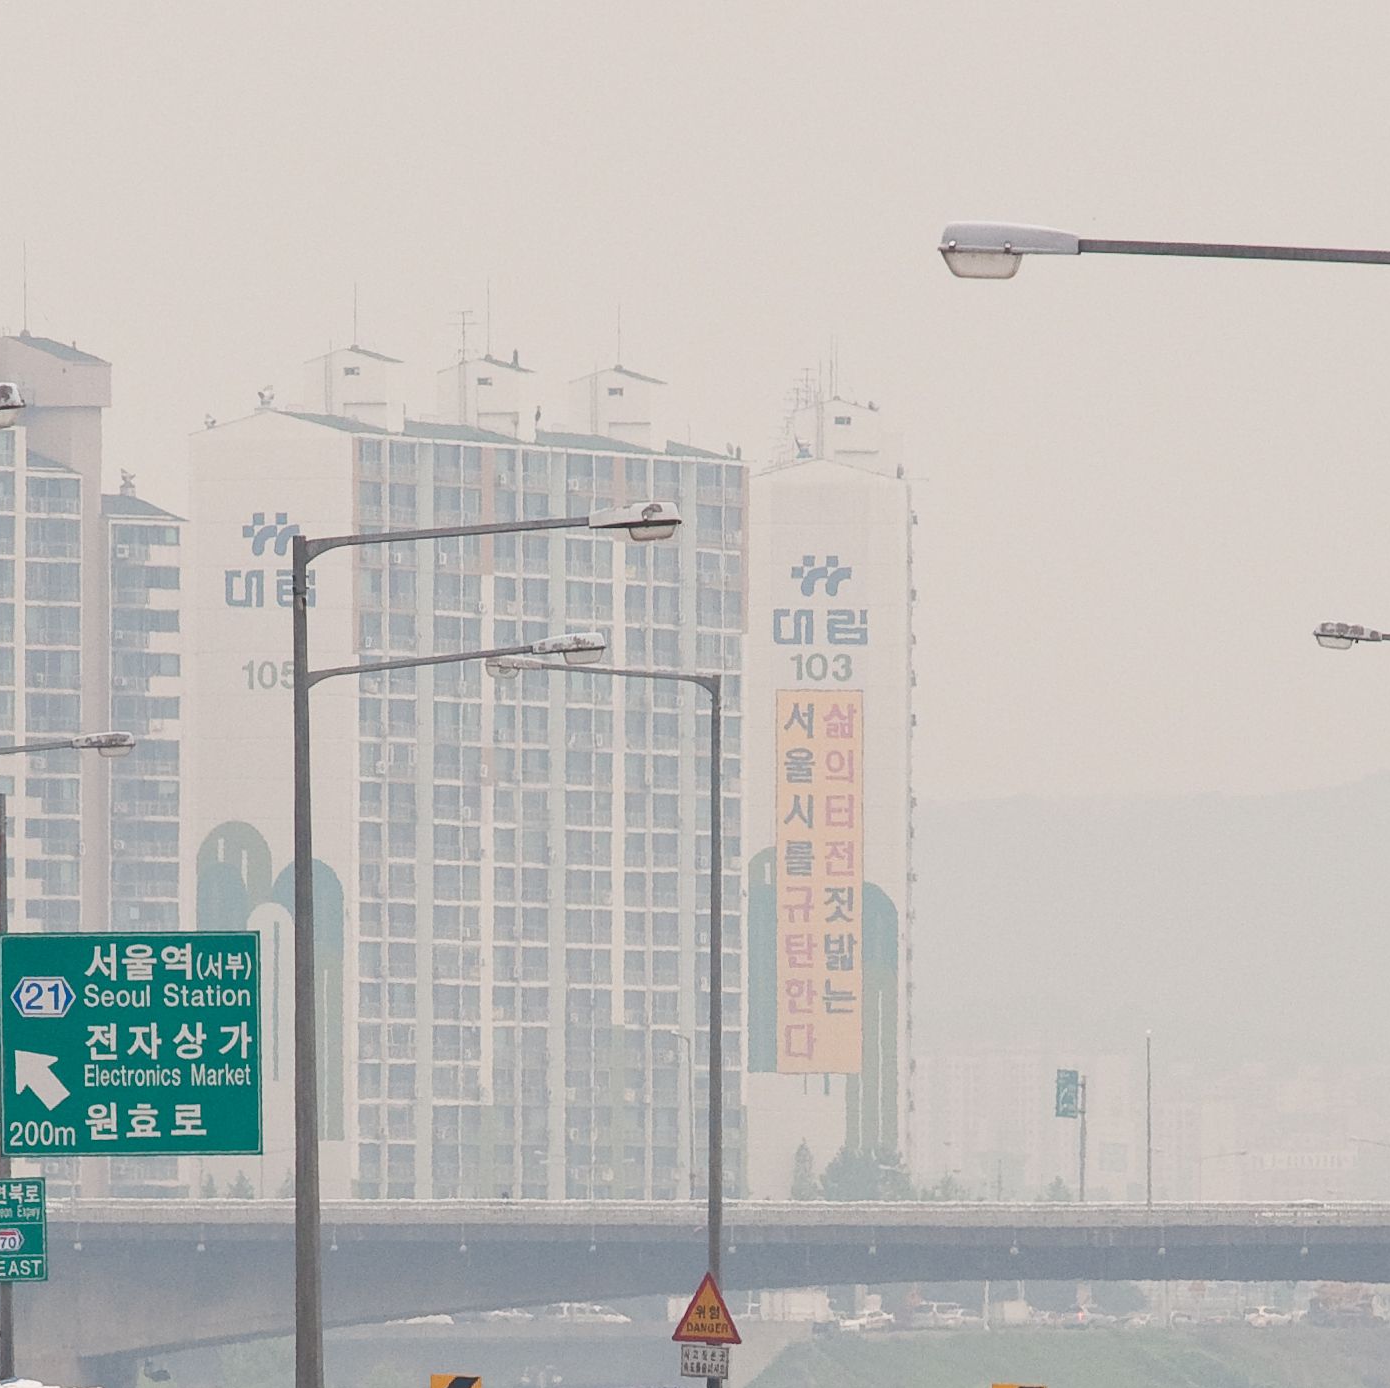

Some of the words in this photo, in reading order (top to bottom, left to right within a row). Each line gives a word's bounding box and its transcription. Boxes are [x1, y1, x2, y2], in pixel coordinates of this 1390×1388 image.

[225, 568, 316, 608] 대림
[773, 609, 868, 645] 대림
[790, 653, 853, 682] 103
[24, 984, 66, 1011] 21
[84, 985, 151, 1008] Seoul
[163, 984, 251, 1007] Station
[85, 1022, 252, 1060] 전자상가
[84, 1063, 182, 1087] Electronics
[190, 1063, 251, 1087] Market
[9, 1121, 76, 1146] 200m
[85, 1102, 208, 1141] 원효로
[0, 1236, 17, 1249] 70
[695, 1305, 721, 1320] 위험
[687, 1322, 729, 1333] DANGER
